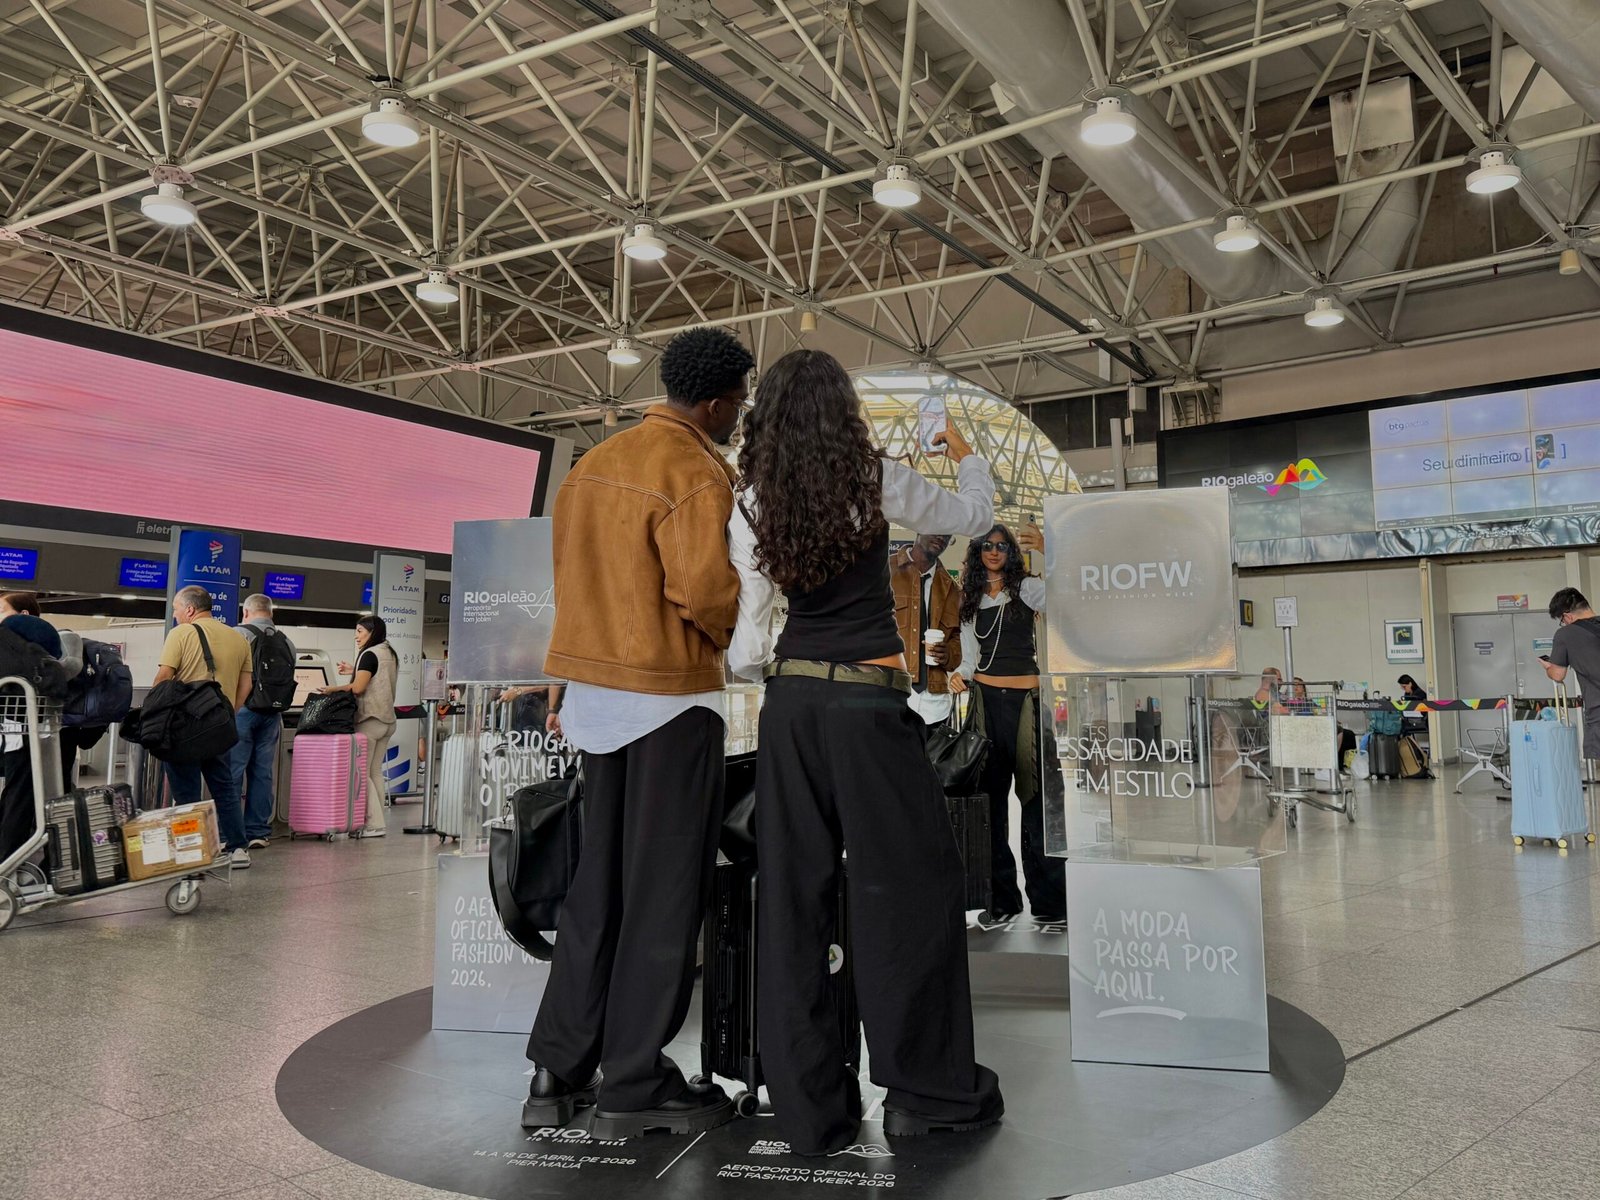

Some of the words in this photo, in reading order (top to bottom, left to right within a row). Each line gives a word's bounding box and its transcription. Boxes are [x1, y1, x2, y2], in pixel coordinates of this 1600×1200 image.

[1422, 458, 1453, 472] Seu
[193, 565, 231, 575] LATAM
[1080, 561, 1192, 591] RIOFW
[392, 585, 420, 593] LATAM
[464, 590, 537, 606] RIOgaleão
[383, 606, 417, 615] Prioridades
[504, 730, 582, 754] RIOGA
[1055, 738, 1104, 761] ESSA
[1106, 738, 1194, 764] CIDADE
[481, 755, 582, 782] MOVIMEN
[1057, 768, 1109, 795] TEM
[1114, 770, 1195, 799] ESTILO
[455, 896, 465, 916] O
[1092, 908, 1109, 936] A
[1120, 909, 1191, 941] MODA
[452, 942, 514, 964] FASHION
[1093, 939, 1170, 971] PASSA
[1182, 944, 1239, 976] POR
[451, 968, 491, 987] 2026.
[1094, 969, 1165, 1002] AQUI.
[552, 1137, 593, 1145] FASHION
[507, 1159, 538, 1167] PIER
[720, 1164, 811, 1175] AEROPORTO
[814, 1169, 869, 1178] OFICIAL
[744, 1172, 809, 1182] FASHION
[812, 1177, 855, 1185] WEEK
[857, 1179, 895, 1187] 2026
